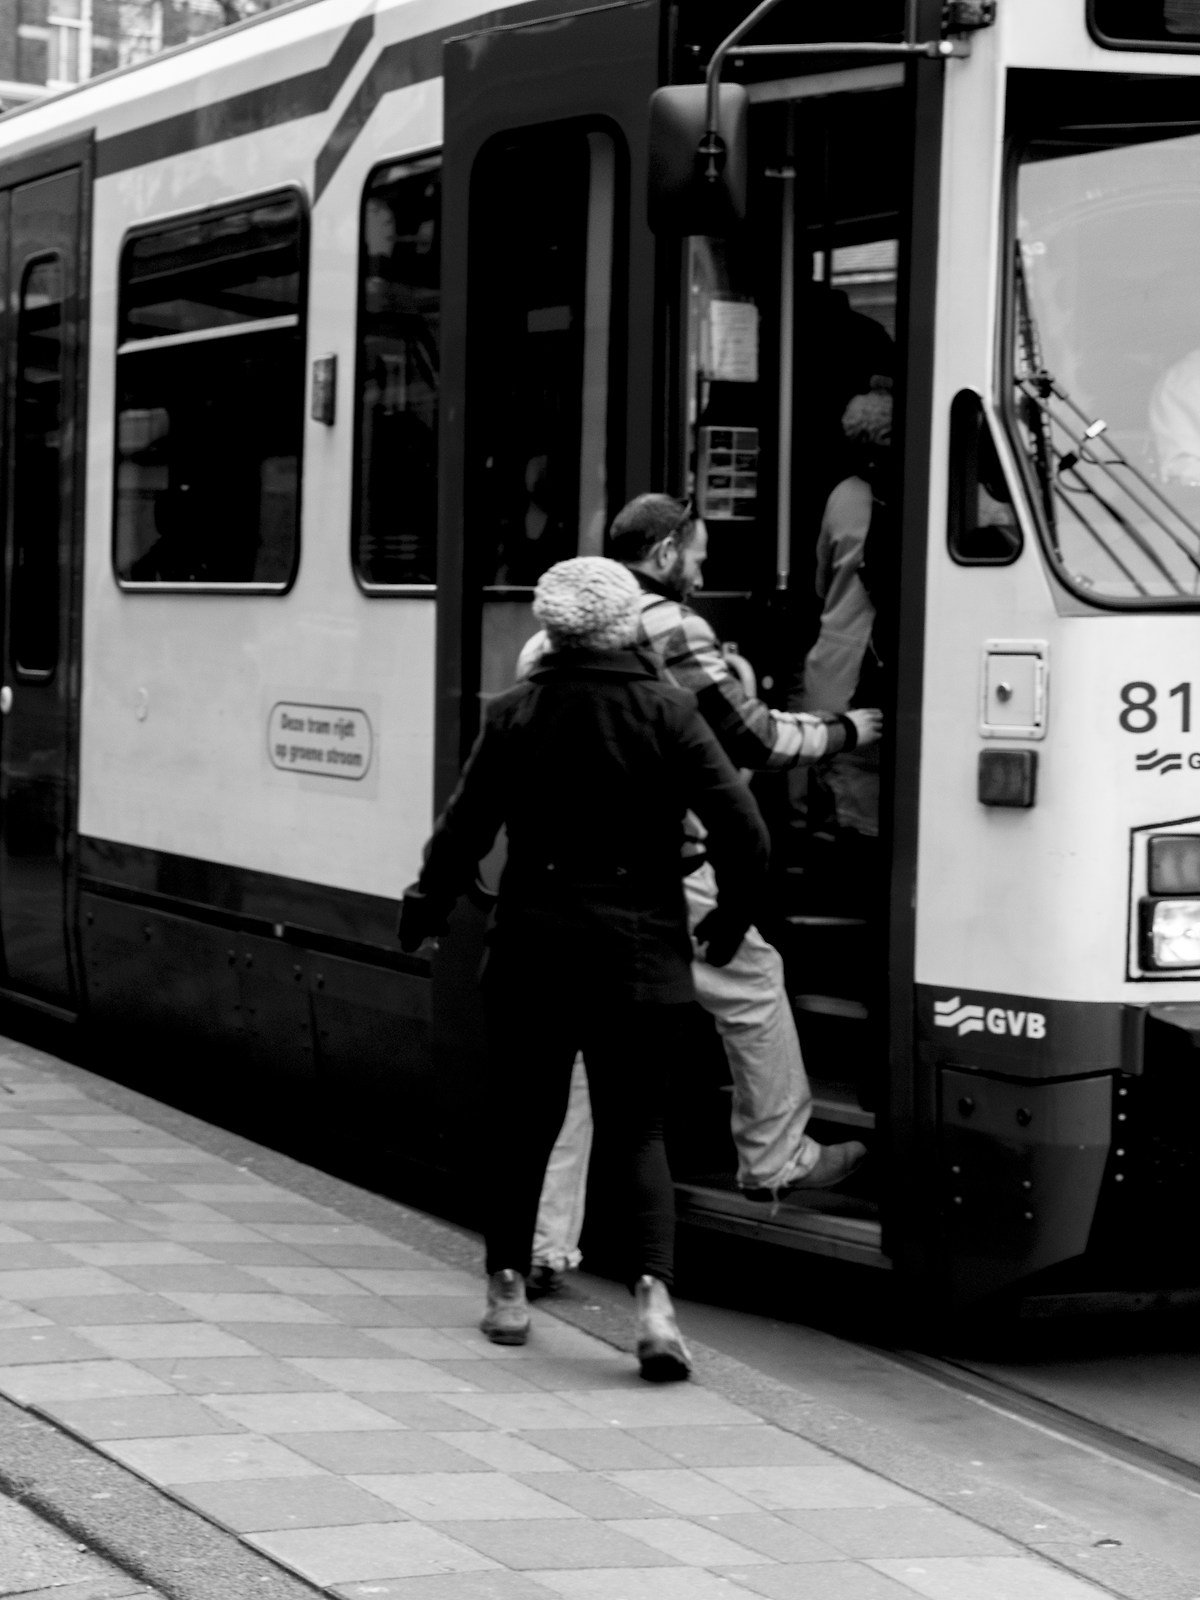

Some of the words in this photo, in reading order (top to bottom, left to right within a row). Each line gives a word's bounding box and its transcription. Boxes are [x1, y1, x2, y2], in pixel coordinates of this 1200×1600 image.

[307, 717, 330, 735] tram
[326, 747, 362, 767] stroom
[986, 1007, 1046, 1040] GVB
